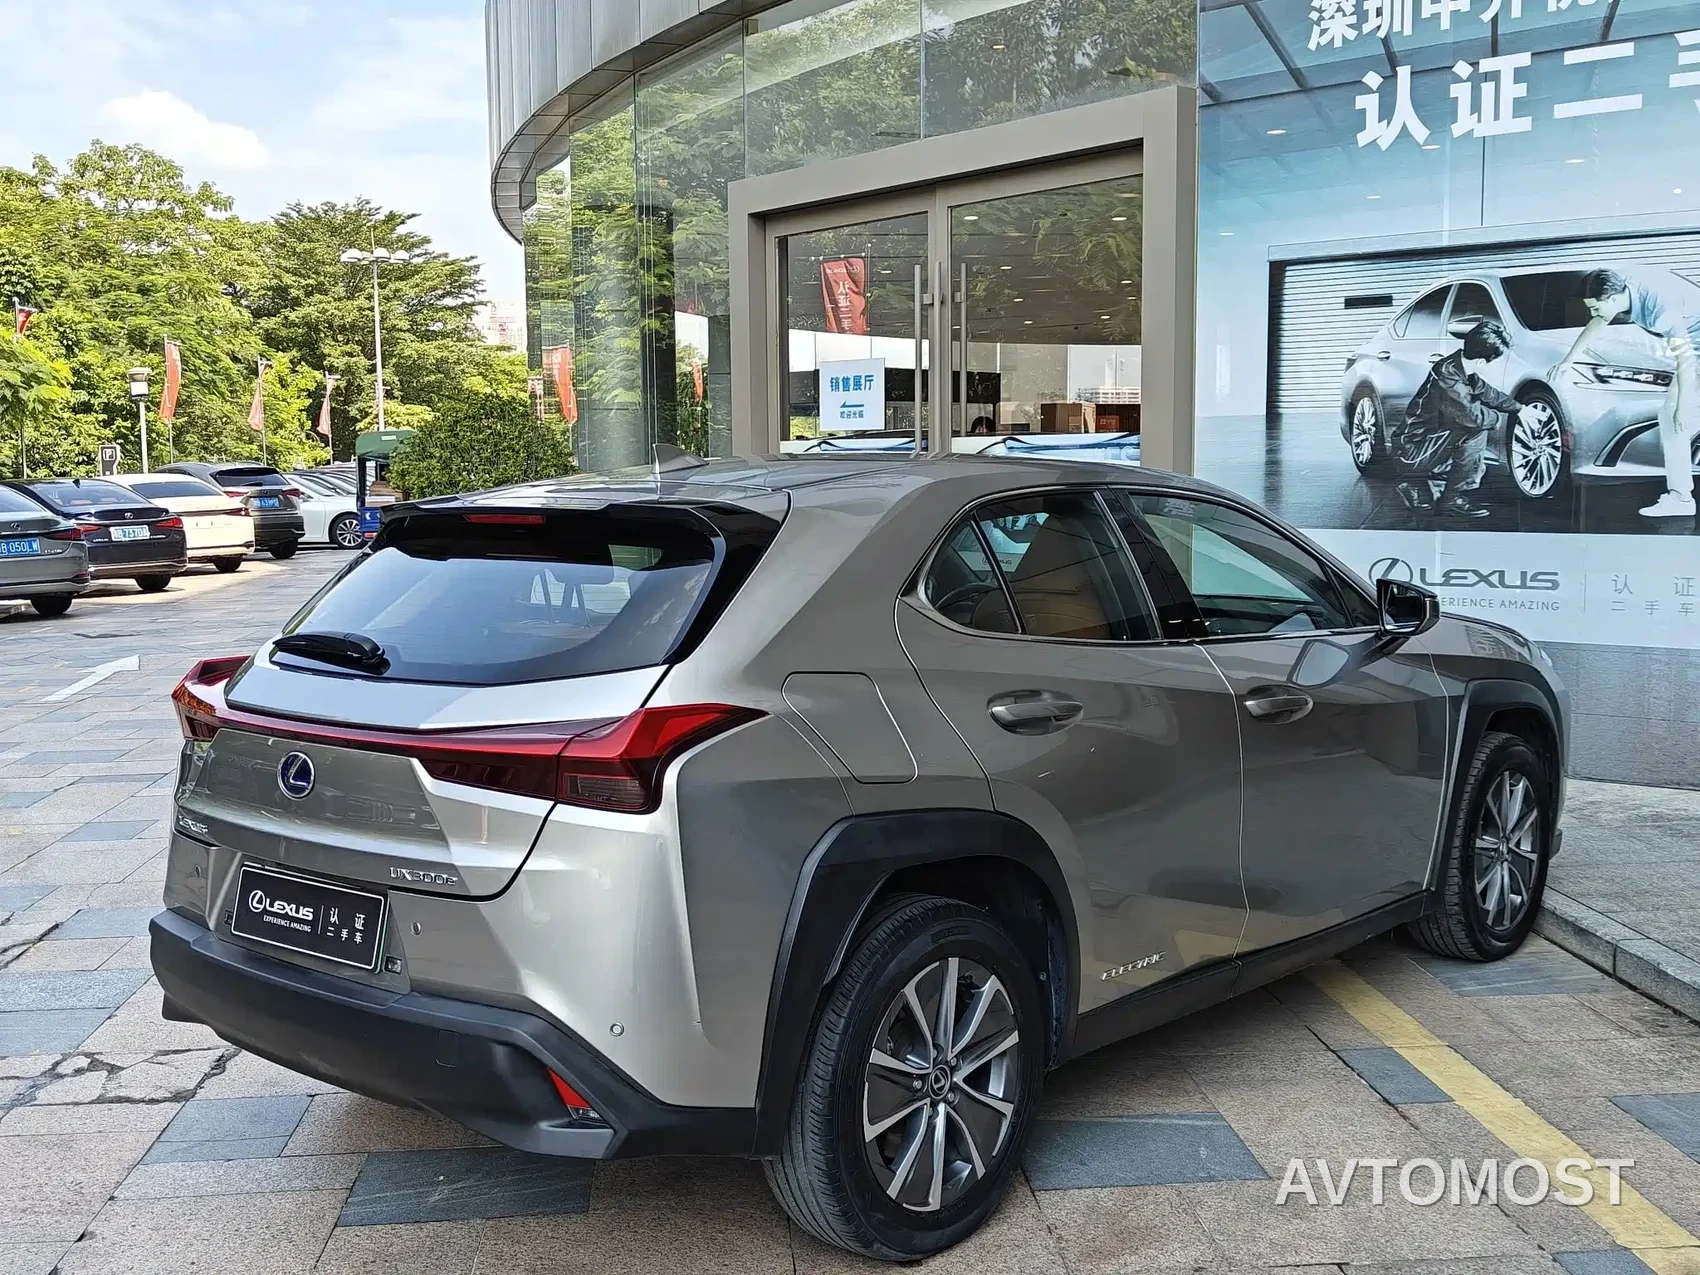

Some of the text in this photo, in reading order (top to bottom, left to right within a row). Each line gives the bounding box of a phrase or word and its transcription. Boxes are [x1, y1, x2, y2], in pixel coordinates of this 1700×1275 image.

[830, 374, 874, 392] 销售展厅
[1419, 567, 1560, 591] LEXUS
[1441, 597, 1560, 612] ERIENCE AMAZING
[1610, 600, 1696, 617] 二手车
[265, 897, 314, 921] LEXUS
[263, 914, 312, 933] EXPERIENCE AMAZING
[326, 926, 363, 945] 二手车
